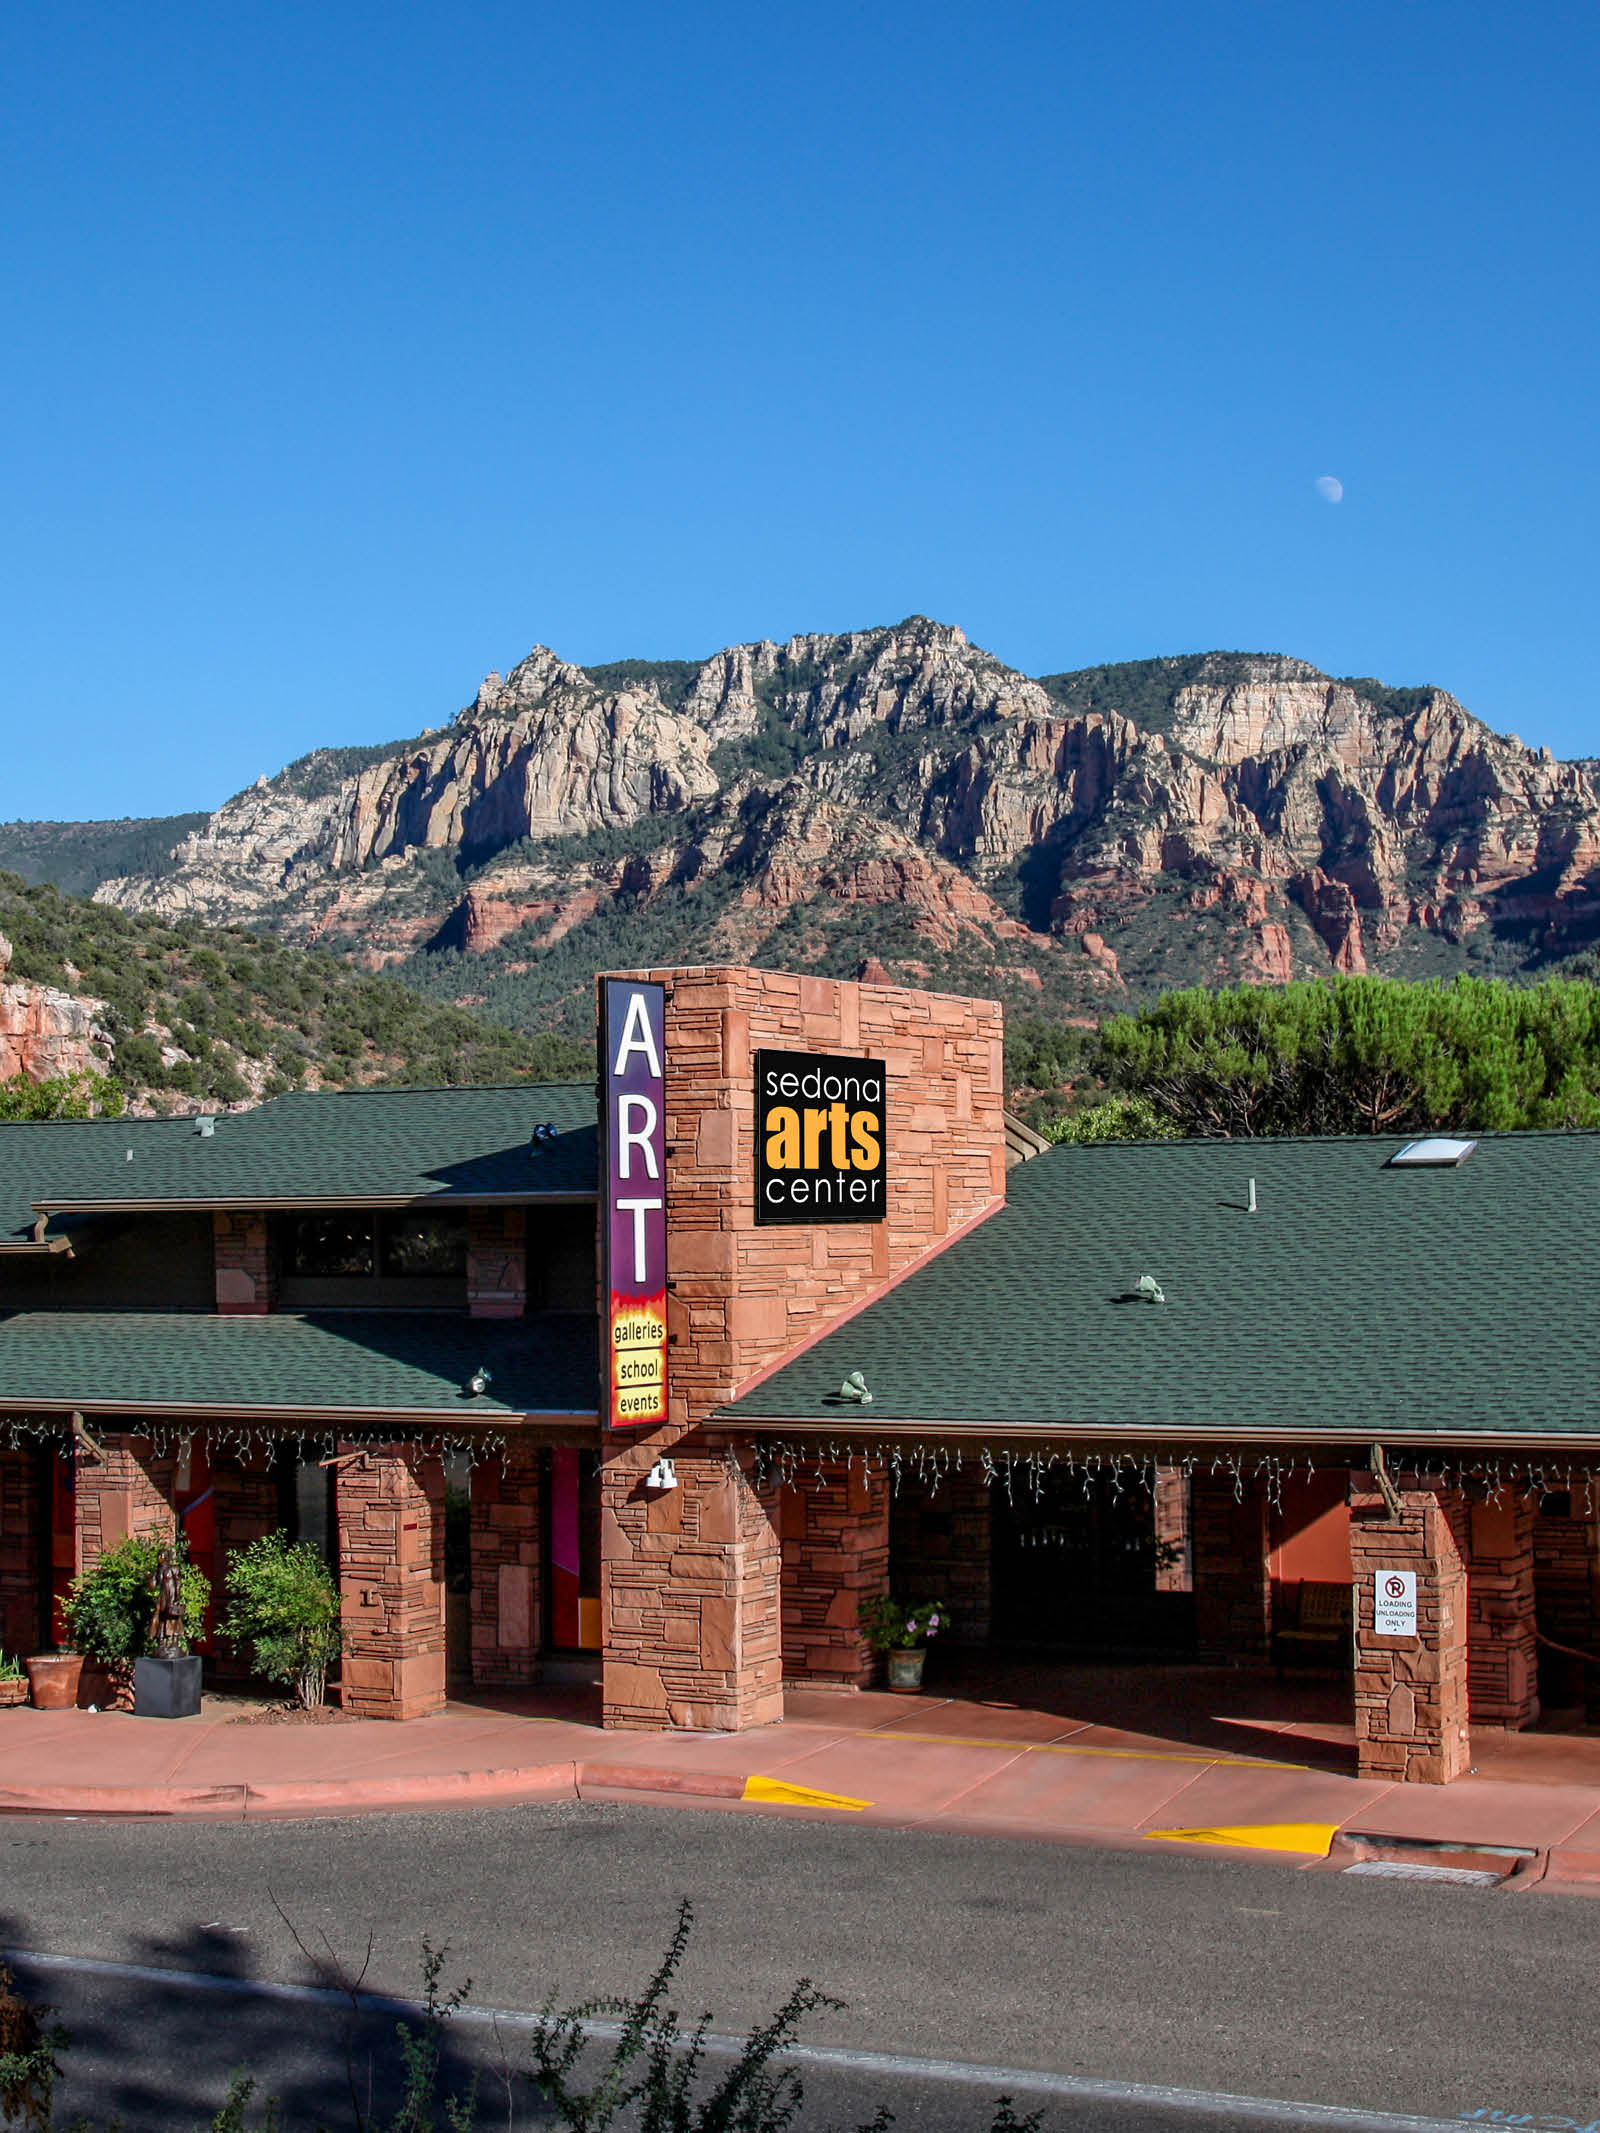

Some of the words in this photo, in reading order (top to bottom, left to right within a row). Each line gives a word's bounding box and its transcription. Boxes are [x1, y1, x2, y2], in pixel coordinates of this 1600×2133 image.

[766, 1067, 880, 1102] sedona
[613, 993, 662, 1283] ART
[765, 1102, 881, 1171] arts
[765, 1171, 881, 1204] center
[614, 1321, 663, 1343] galleries
[620, 1359, 658, 1379] school
[620, 1394, 659, 1413] events
[1376, 1609, 1415, 1618] UNLOADING
[1379, 1600, 1412, 1608] LOADING
[1385, 1619, 1406, 1627] ONLY
